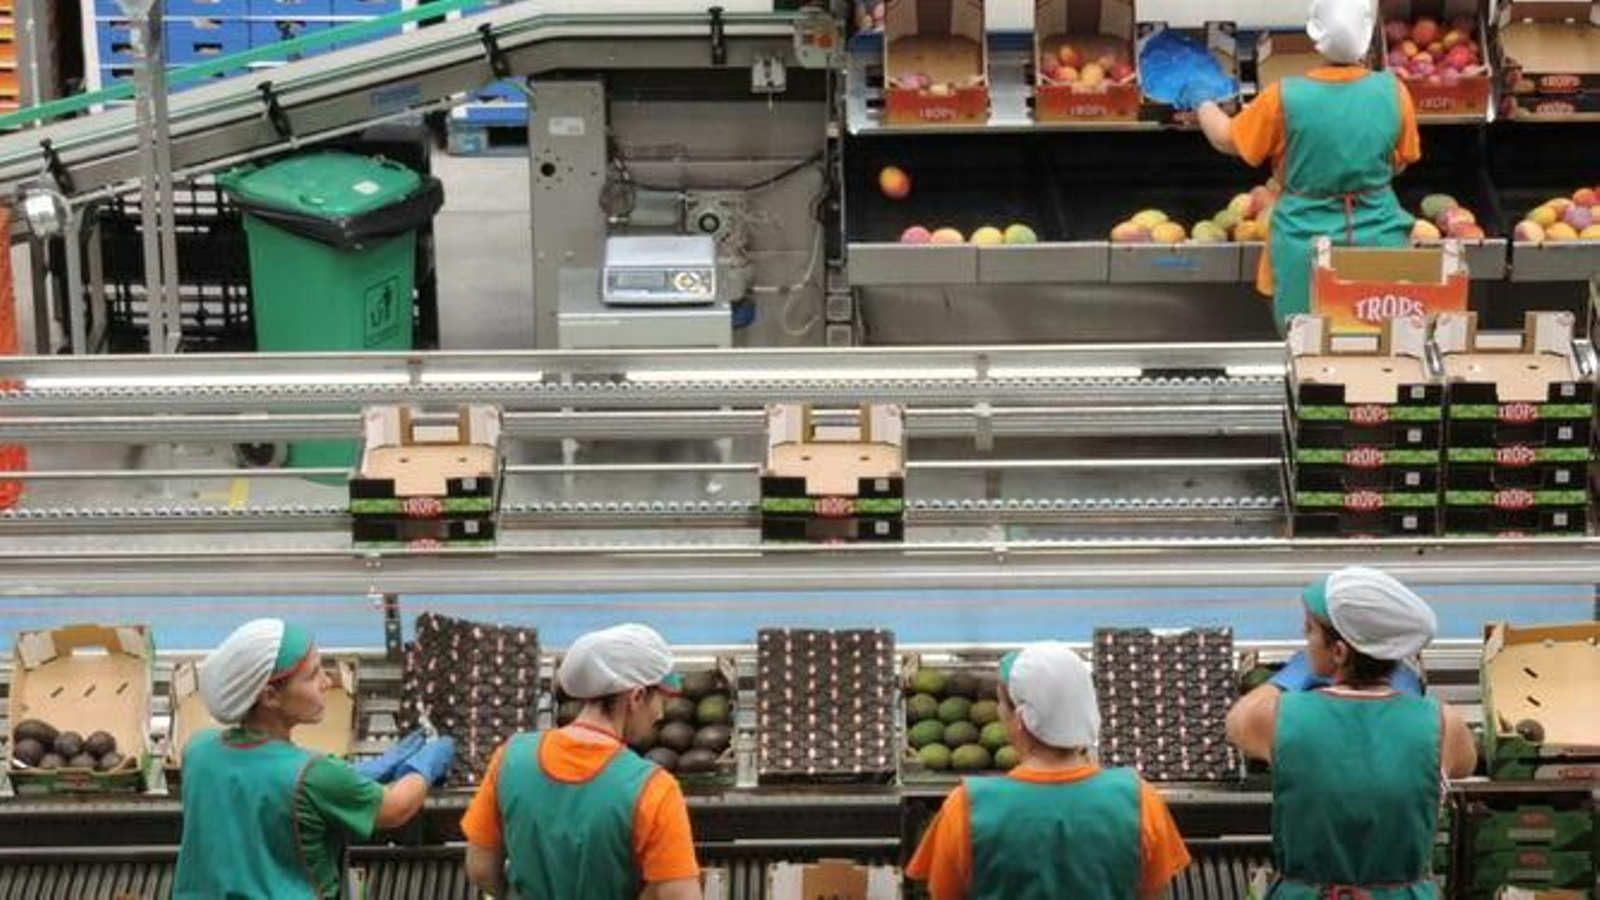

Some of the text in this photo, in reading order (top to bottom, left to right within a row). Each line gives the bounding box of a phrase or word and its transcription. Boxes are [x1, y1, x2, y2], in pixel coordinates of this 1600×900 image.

[1355, 294, 1425, 321] TROPS
[1349, 405, 1389, 423] TROPS
[1498, 403, 1538, 421] TROPS
[1344, 448, 1385, 466] TROPS
[1497, 446, 1536, 464] TROPS
[1344, 491, 1384, 509] TROPS
[1495, 490, 1534, 507] TROPS
